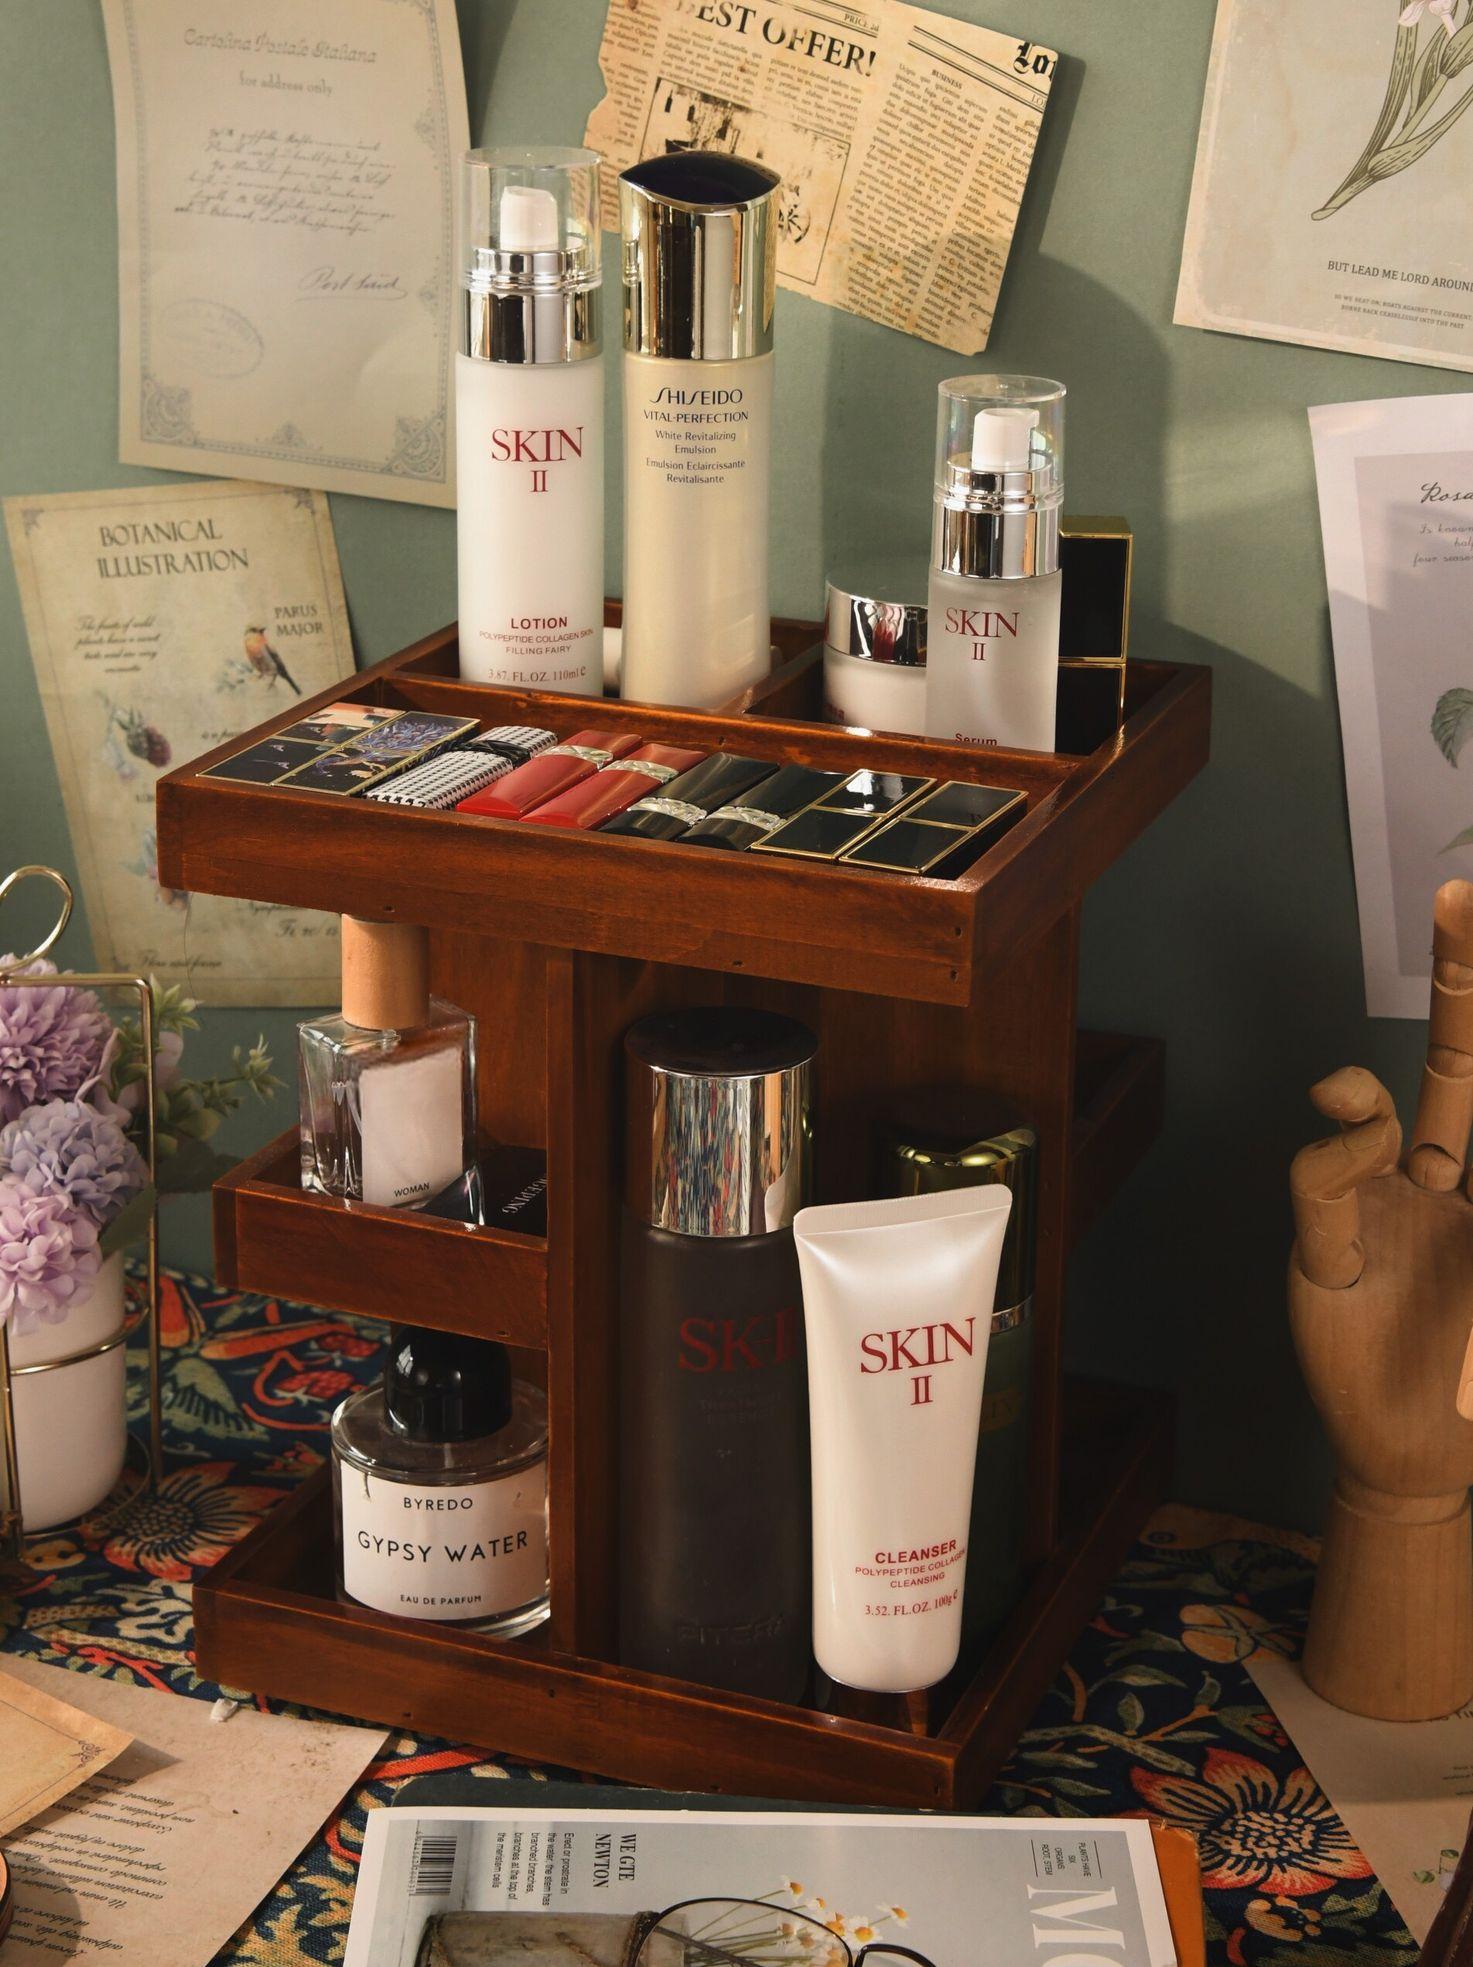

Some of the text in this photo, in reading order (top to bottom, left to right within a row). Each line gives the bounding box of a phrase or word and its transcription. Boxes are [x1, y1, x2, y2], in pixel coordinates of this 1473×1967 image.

[678, 0, 756, 34] EST
[762, 16, 877, 77] OFFER!
[932, 69, 963, 90] BUSINESS
[1328, 260, 1349, 272] BUT
[1352, 264, 1379, 277] LEAD
[1382, 269, 1398, 280] ME
[1401, 272, 1429, 285] LORD
[649, 387, 743, 405] SHISEIDO
[644, 409, 749, 423] VITAL-PERFECTION
[492, 426, 584, 462] SKIN
[656, 430, 736, 442] White Revitalizing
[675, 444, 716, 454] Emulsion
[646, 458, 746, 471] Emulsion Eclaircissante
[530, 470, 549, 493] II
[666, 473, 724, 484] Revitalisante
[100, 518, 223, 547] BOTANICAL
[97, 548, 249, 579] ILLUSTRATION
[274, 604, 318, 620] PARUS
[275, 620, 323, 638] MAJOR
[511, 616, 568, 630] LOTION
[945, 607, 1020, 638] SKIN
[480, 630, 534, 643] POLYPEPTIDE
[535, 632, 579, 643] COLLAGEN
[505, 645, 572, 655] FILLING FAIRY
[972, 642, 986, 661] II
[955, 733, 998, 747] Serum
[394, 1182, 430, 1198] WOMAN
[860, 1316, 976, 1374] SKIN
[910, 1375, 934, 1406] II
[403, 1497, 474, 1511] BYREDO
[358, 1530, 528, 1563] GYPSY WATER
[875, 1539, 957, 1564] CLEANSER
[855, 1565, 926, 1577] POLYPEPTIDE
[890, 1572, 945, 1588] CLEANSING
[400, 1594, 482, 1605] EAU DE PARFUM
[497, 1833, 506, 1842] the
[548, 1833, 557, 1842] the
[564, 1833, 574, 1849] Erect
[512, 1833, 523, 1860] branches
[529, 1833, 540, 1861] branched
[594, 1834, 611, 1887] NEWTON
[619, 1834, 636, 1880] WE GTE
[510, 1870, 519, 1880] the
[545, 1865, 554, 1874] the
[561, 1858, 570, 1886] prostrate
[492, 1874, 501, 1888] cells
[507, 1882, 518, 1892] top
[544, 1876, 552, 1891] stem
[542, 1894, 552, 1905] has
